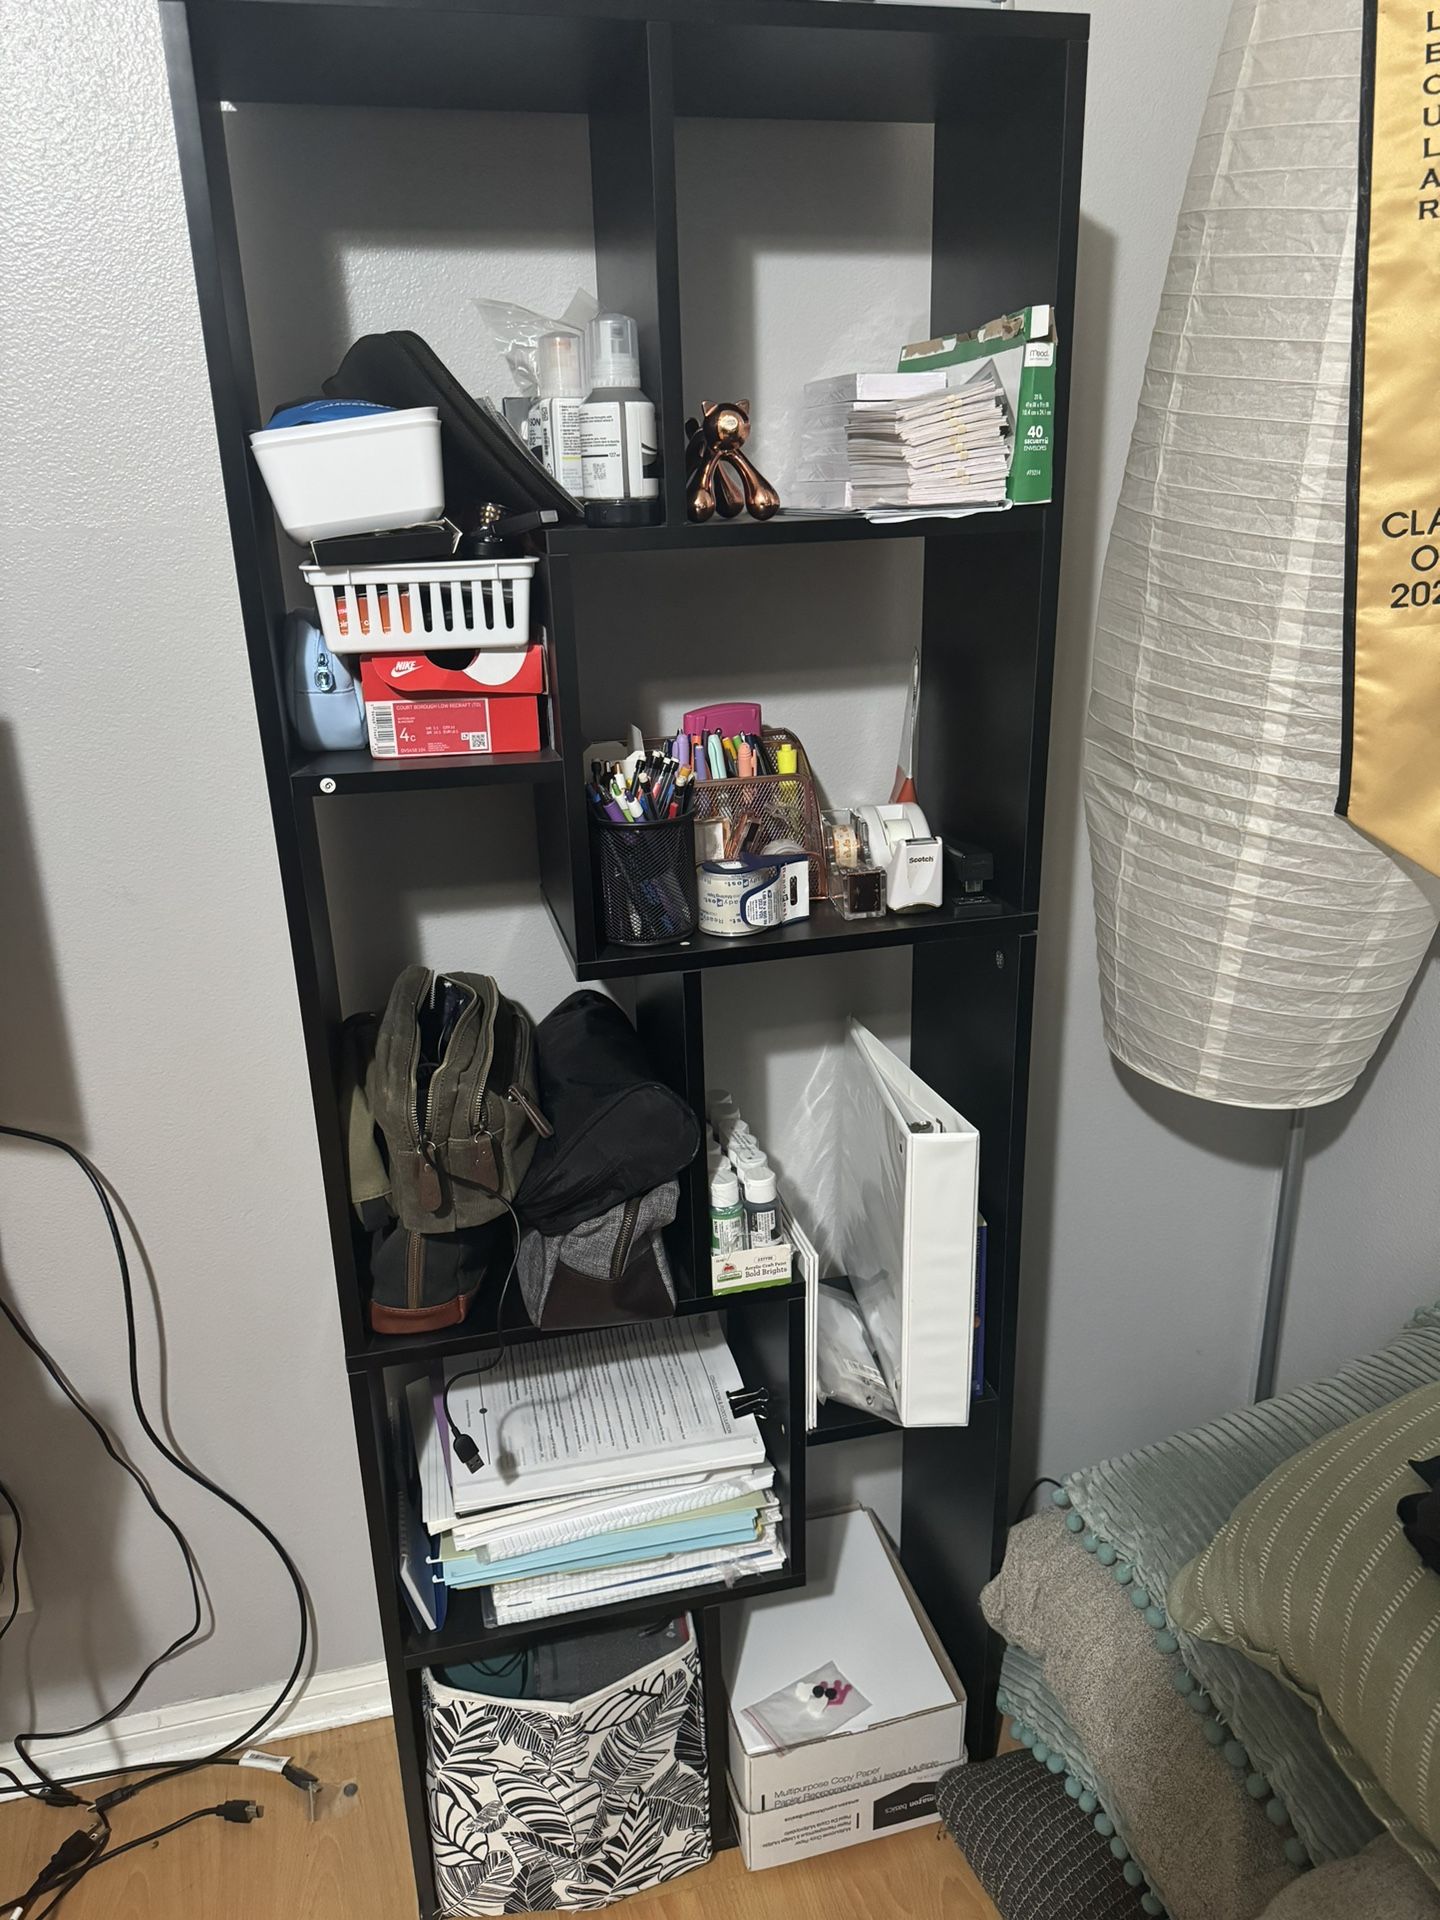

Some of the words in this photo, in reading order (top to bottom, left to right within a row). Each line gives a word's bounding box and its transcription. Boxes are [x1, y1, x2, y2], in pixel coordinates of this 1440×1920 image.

[1027, 425, 1043, 438] 40
[395, 660, 417, 671] NIKE
[413, 702, 437, 710] BOROUGH
[908, 856, 934, 864] Scotch
[745, 1269, 761, 1278] Bold
[762, 1267, 788, 1276] Brights
[774, 1780, 829, 1798] Multipurpose
[831, 1774, 854, 1785] Copy
[856, 1767, 880, 1779] Paper
[909, 1794, 936, 1807] mazon
[885, 1803, 908, 1814] basics
